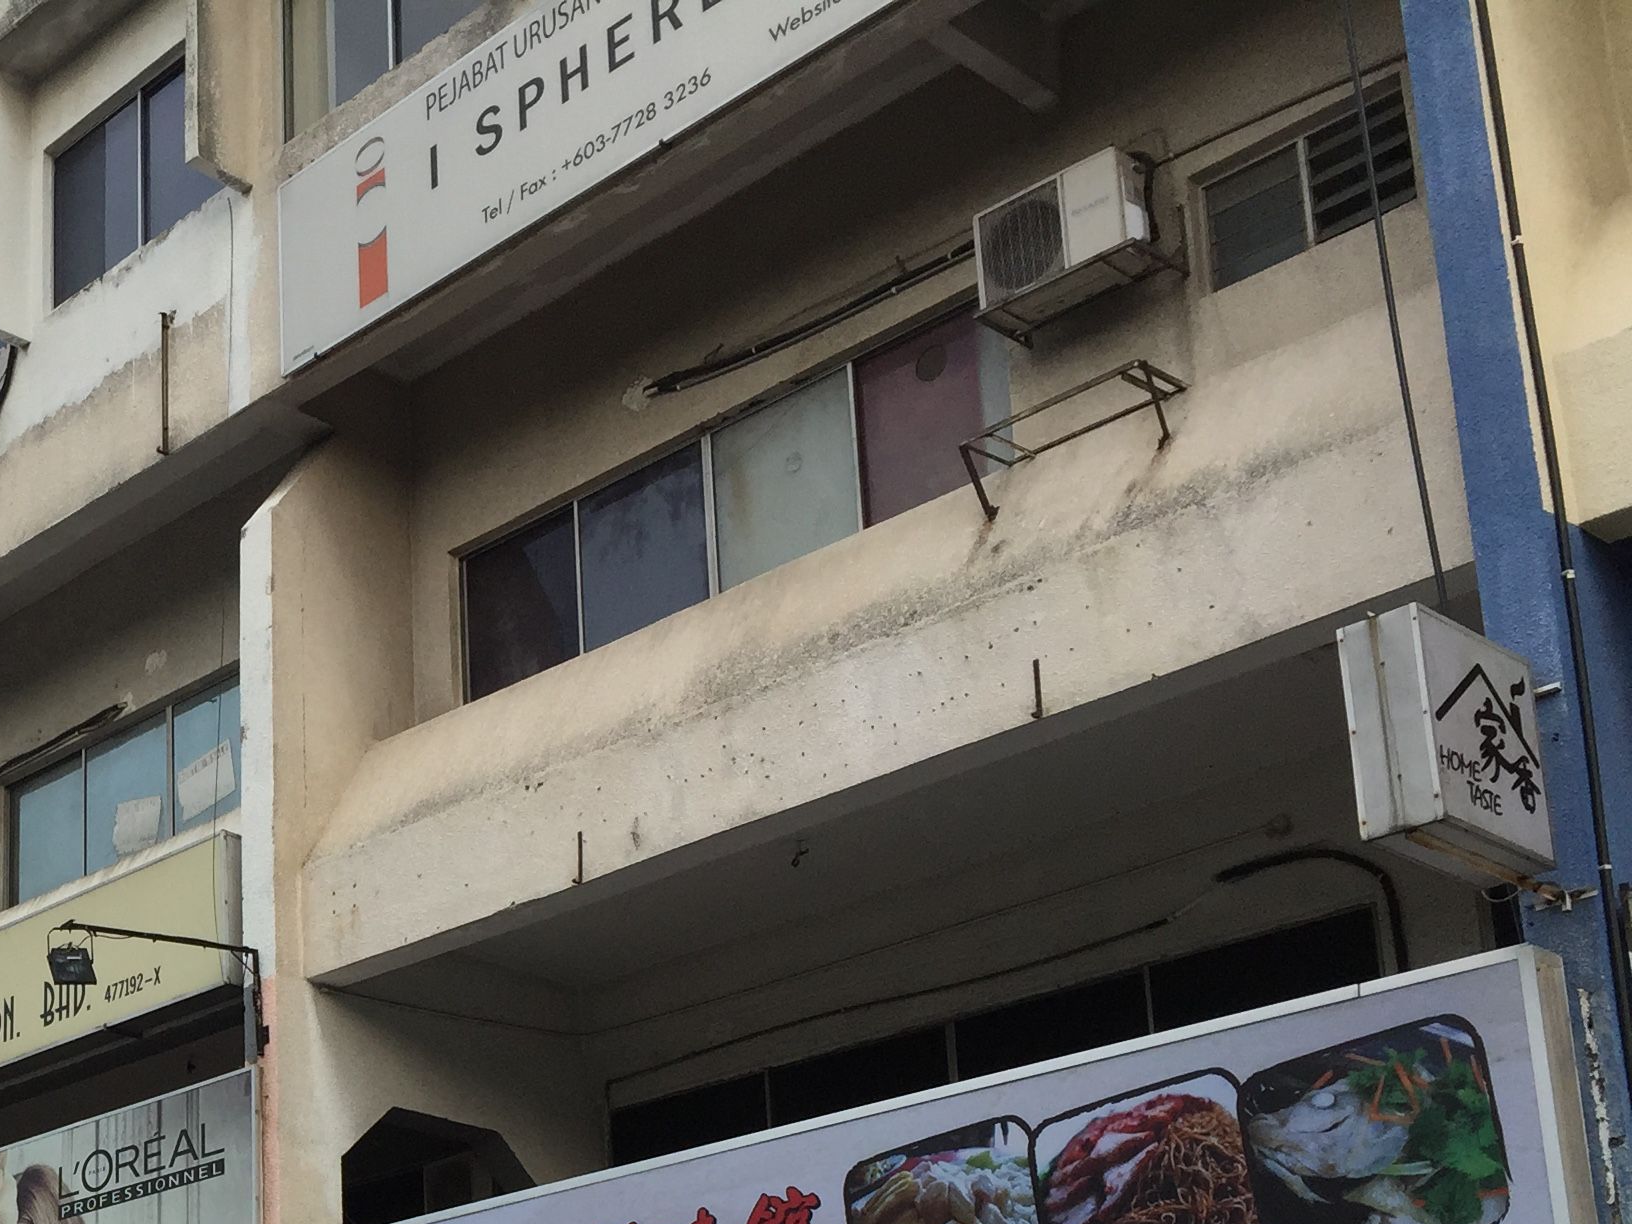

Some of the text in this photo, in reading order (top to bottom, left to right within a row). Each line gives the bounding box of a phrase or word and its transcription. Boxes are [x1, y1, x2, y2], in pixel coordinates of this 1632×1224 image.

[426, 41, 508, 120] PEJABAT
[429, 0, 719, 190] I SPHER
[481, 198, 503, 224] Tel
[520, 175, 547, 201] Fax
[561, 102, 657, 172] +603-7728
[663, 67, 712, 110] 3236
[1440, 745, 1482, 782] HOME
[1467, 780, 1504, 816] TASTE
[104, 966, 161, 1003] 477192-X
[60, 1163, 223, 1218] PROFESSIONNEL
